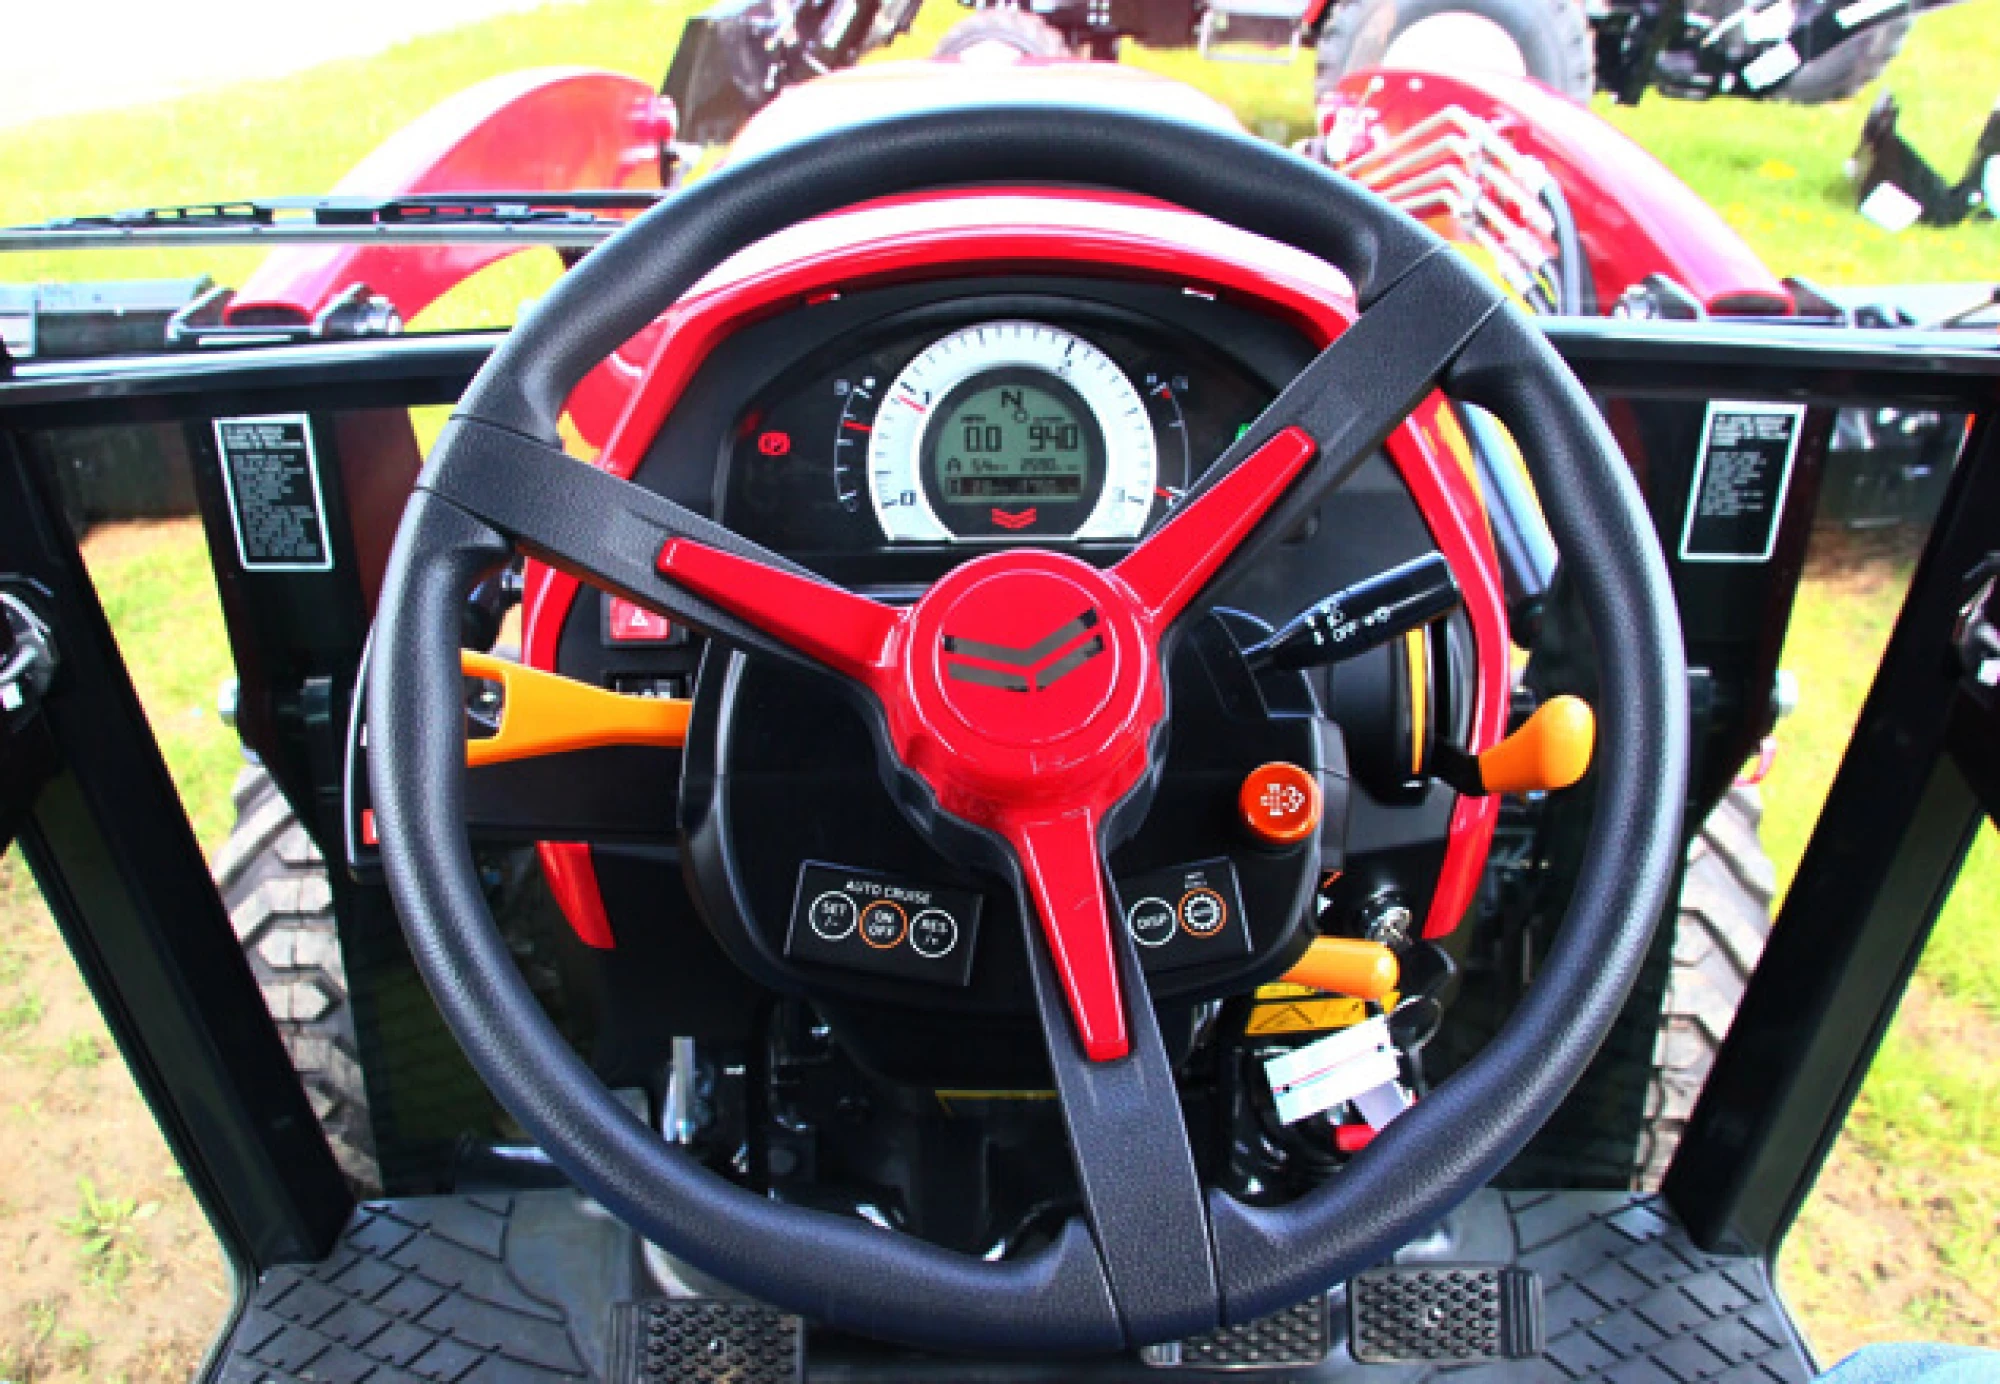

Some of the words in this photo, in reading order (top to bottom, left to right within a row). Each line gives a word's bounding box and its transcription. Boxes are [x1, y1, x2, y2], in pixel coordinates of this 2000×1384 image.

[1001, 390, 1022, 409] N
[1029, 425, 1078, 452] 940
[900, 490, 916, 506] 0
[846, 880, 882, 896] AUTO
[884, 886, 932, 904] CRUISE
[821, 901, 848, 915] SET
[873, 911, 894, 924] ON
[1137, 912, 1169, 930] DISP
[867, 924, 894, 937] OFF
[920, 919, 949, 934] RES
